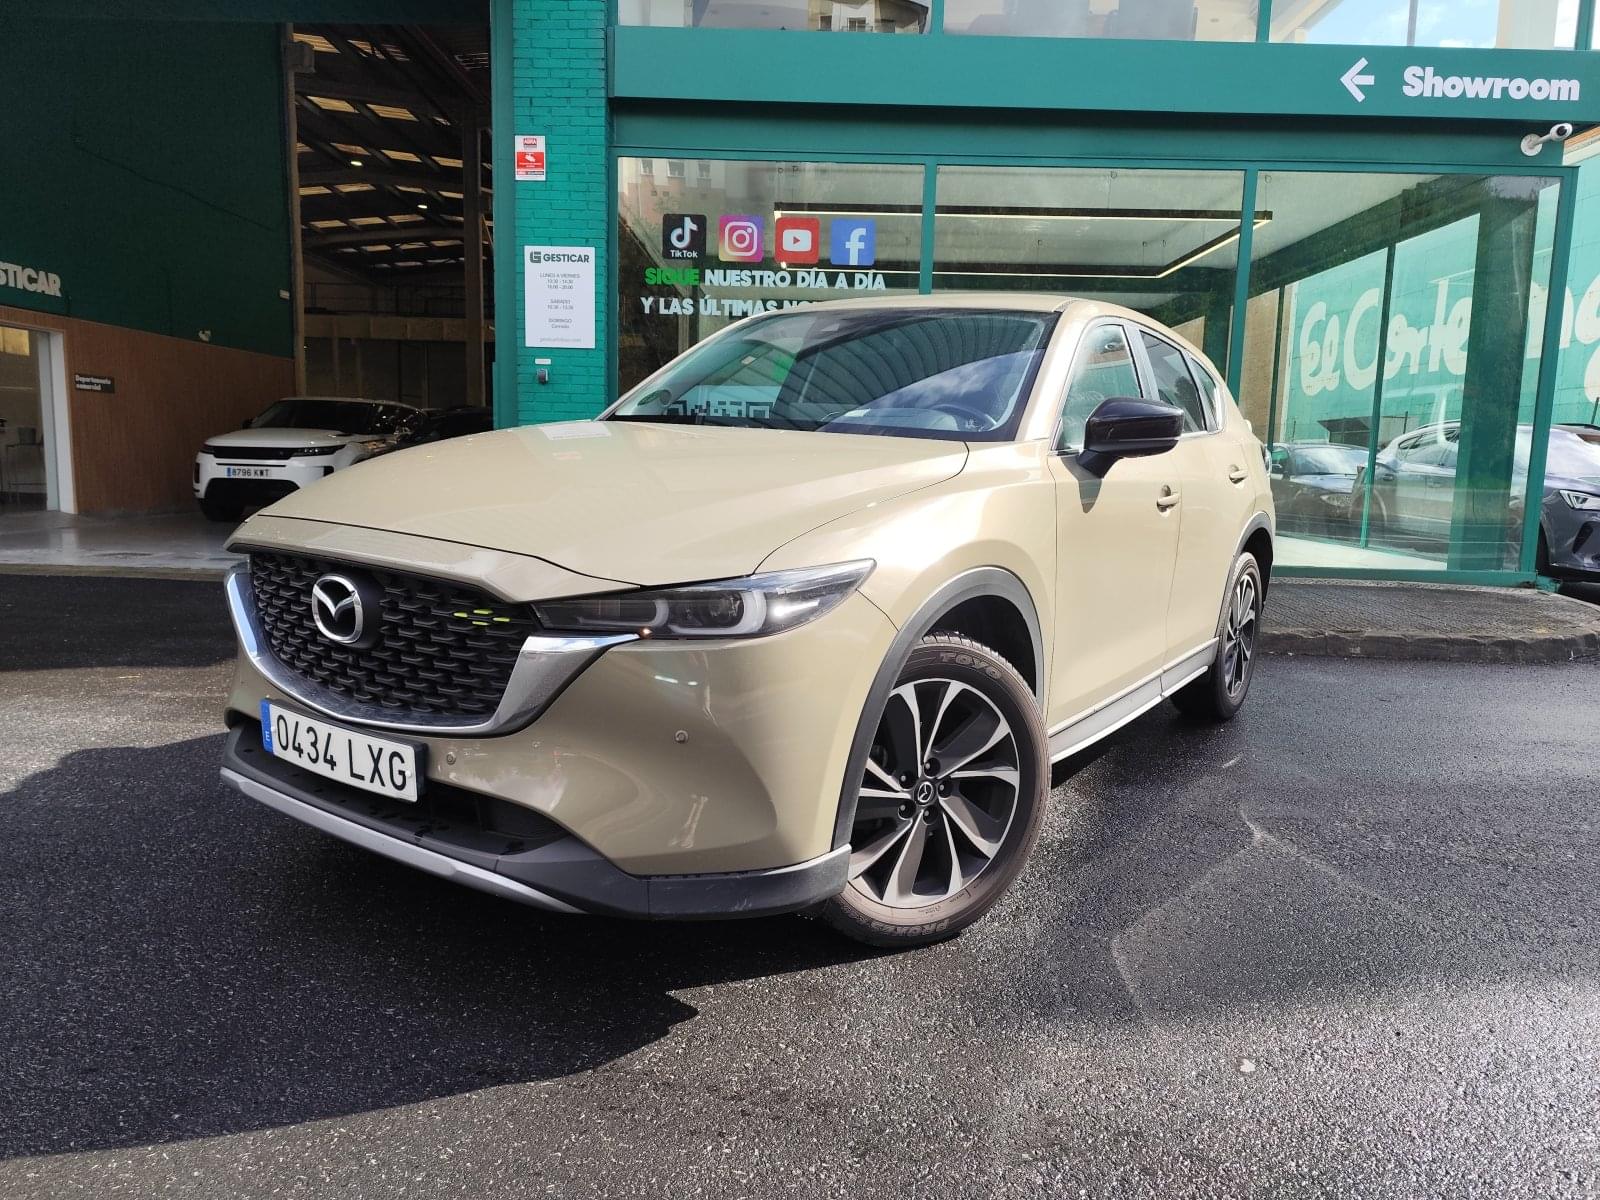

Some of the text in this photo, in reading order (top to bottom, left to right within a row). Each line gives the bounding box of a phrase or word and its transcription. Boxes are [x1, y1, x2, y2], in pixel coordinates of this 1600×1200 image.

[1402, 65, 1581, 101] Showroom
[543, 253, 590, 263] GESTICAR
[670, 250, 698, 259] TikTok
[705, 268, 791, 288] NUESTRO
[797, 267, 831, 289] DÍA
[835, 272, 849, 289] A
[854, 268, 886, 290] DÍA
[640, 296, 654, 315] Y
[659, 297, 694, 316] LAS
[1300, 301, 1340, 396] El
[1343, 279, 1473, 391] Corte
[231, 468, 252, 477] 8796
[940, 651, 1001, 680] TOYO
[276, 714, 337, 771] 0434
[348, 738, 407, 791] LXG
